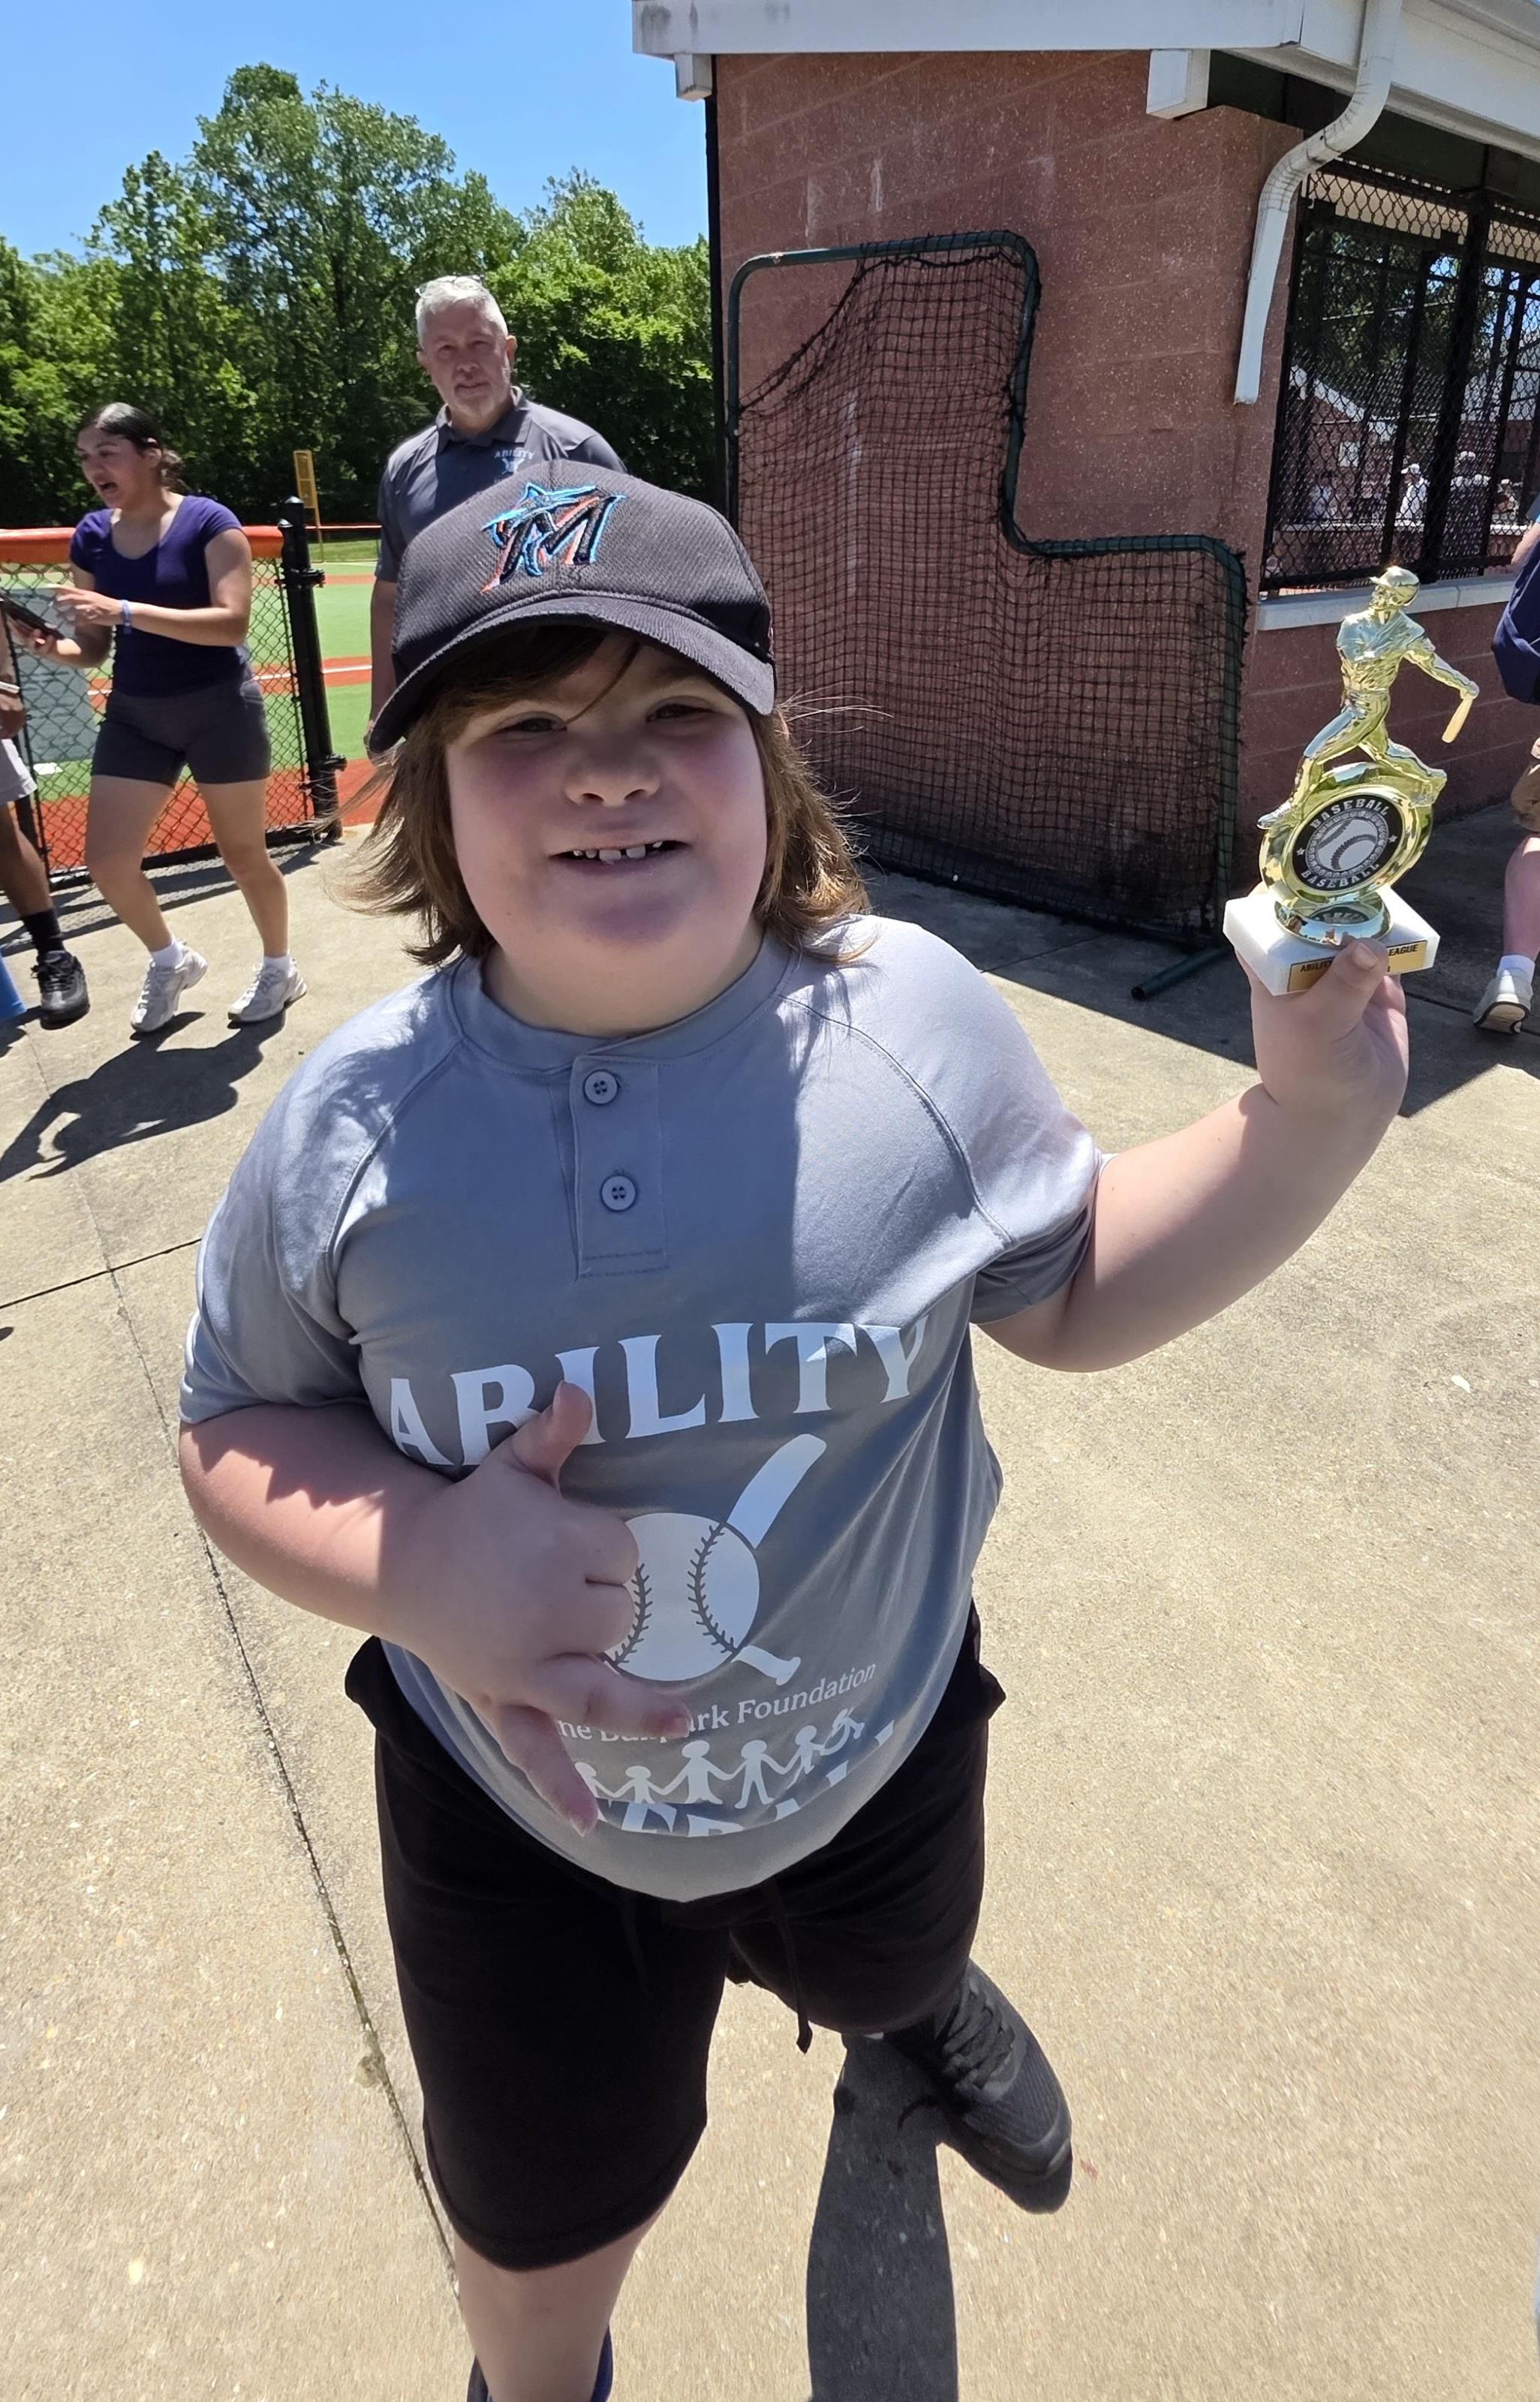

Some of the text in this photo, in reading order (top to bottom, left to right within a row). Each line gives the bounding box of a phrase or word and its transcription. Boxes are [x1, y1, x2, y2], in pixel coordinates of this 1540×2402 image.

[494, 450, 535, 459] ABILITY
[1310, 798, 1390, 829] BASEBALL
[1301, 863, 1380, 888] BASEBALL
[1388, 944, 1419, 956] EAGUE
[390, 1315, 929, 1466] ABILITY
[737, 1663, 877, 1724] Foundation
